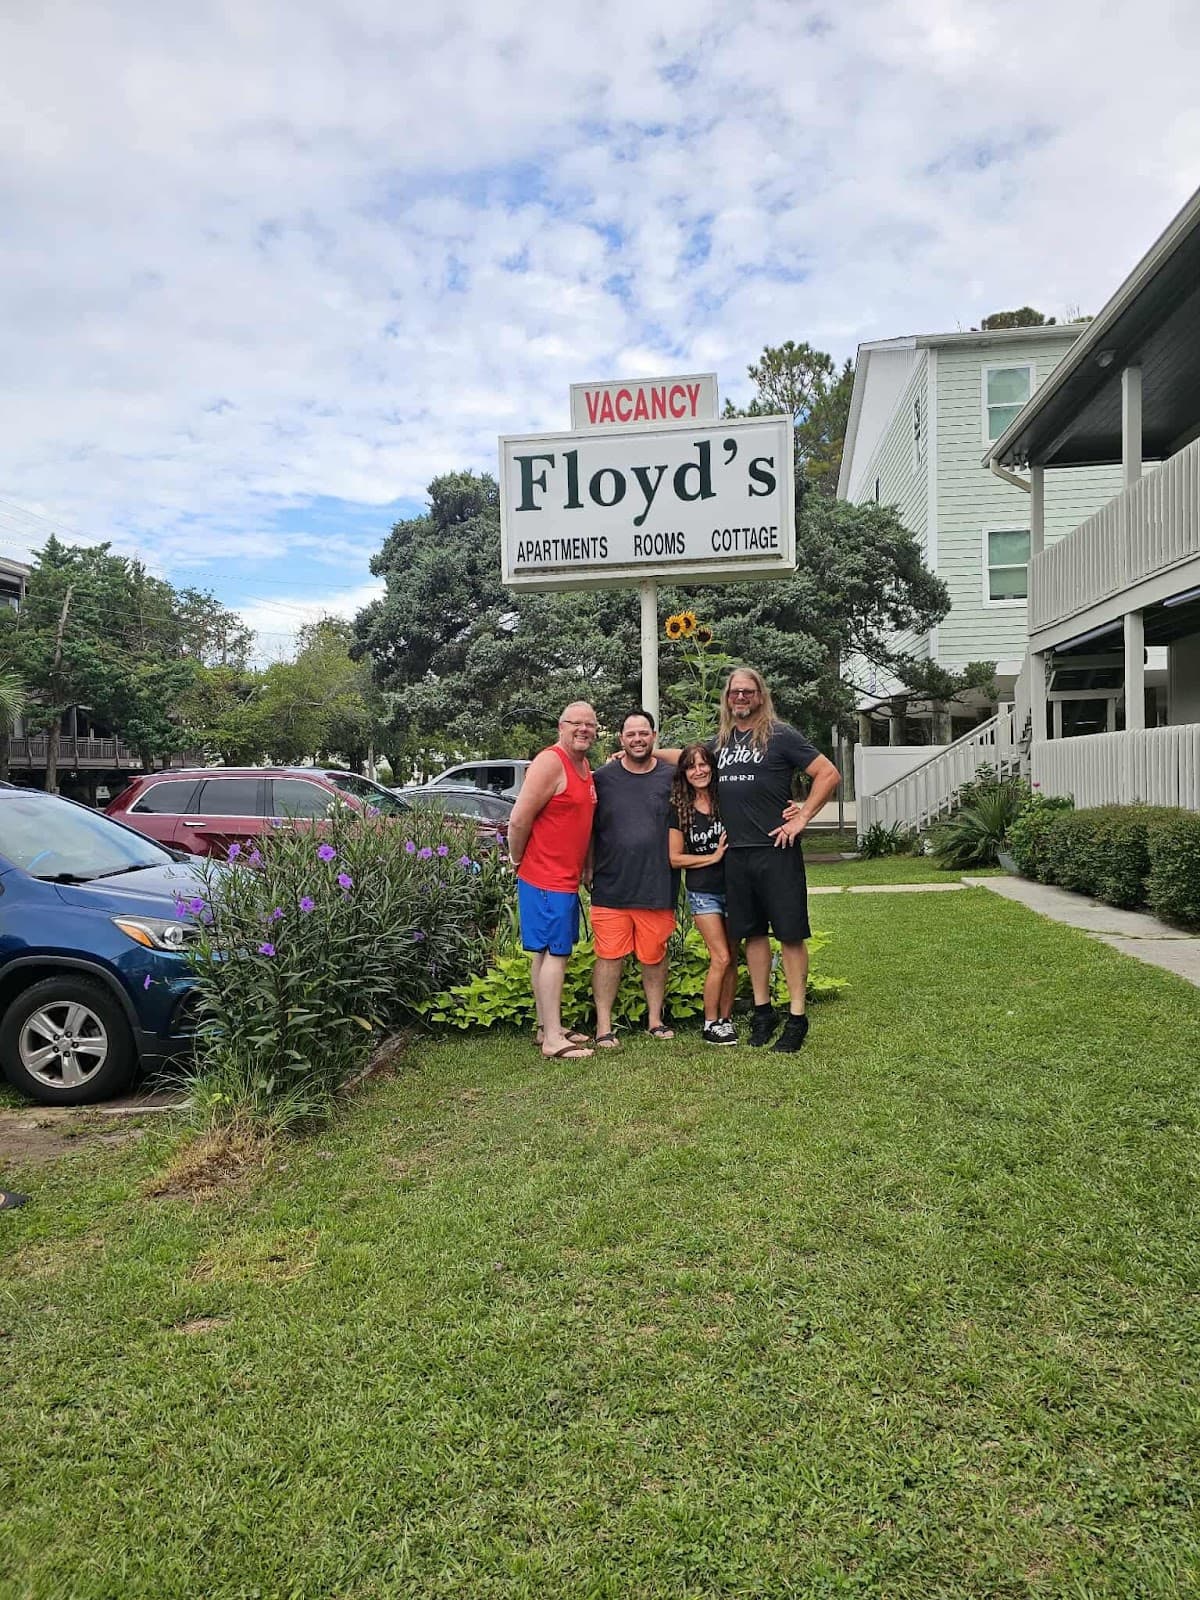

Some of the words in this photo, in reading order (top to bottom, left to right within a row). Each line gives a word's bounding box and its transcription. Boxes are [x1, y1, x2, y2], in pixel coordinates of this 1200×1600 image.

[585, 383, 701, 424] VACANCY
[513, 438, 777, 527] Floyd's
[517, 536, 608, 563] APARTMENTS
[634, 532, 685, 558] ROOMS
[711, 526, 778, 552] COTTAGE
[717, 744, 764, 769] Better
[690, 821, 725, 845] Togeth
